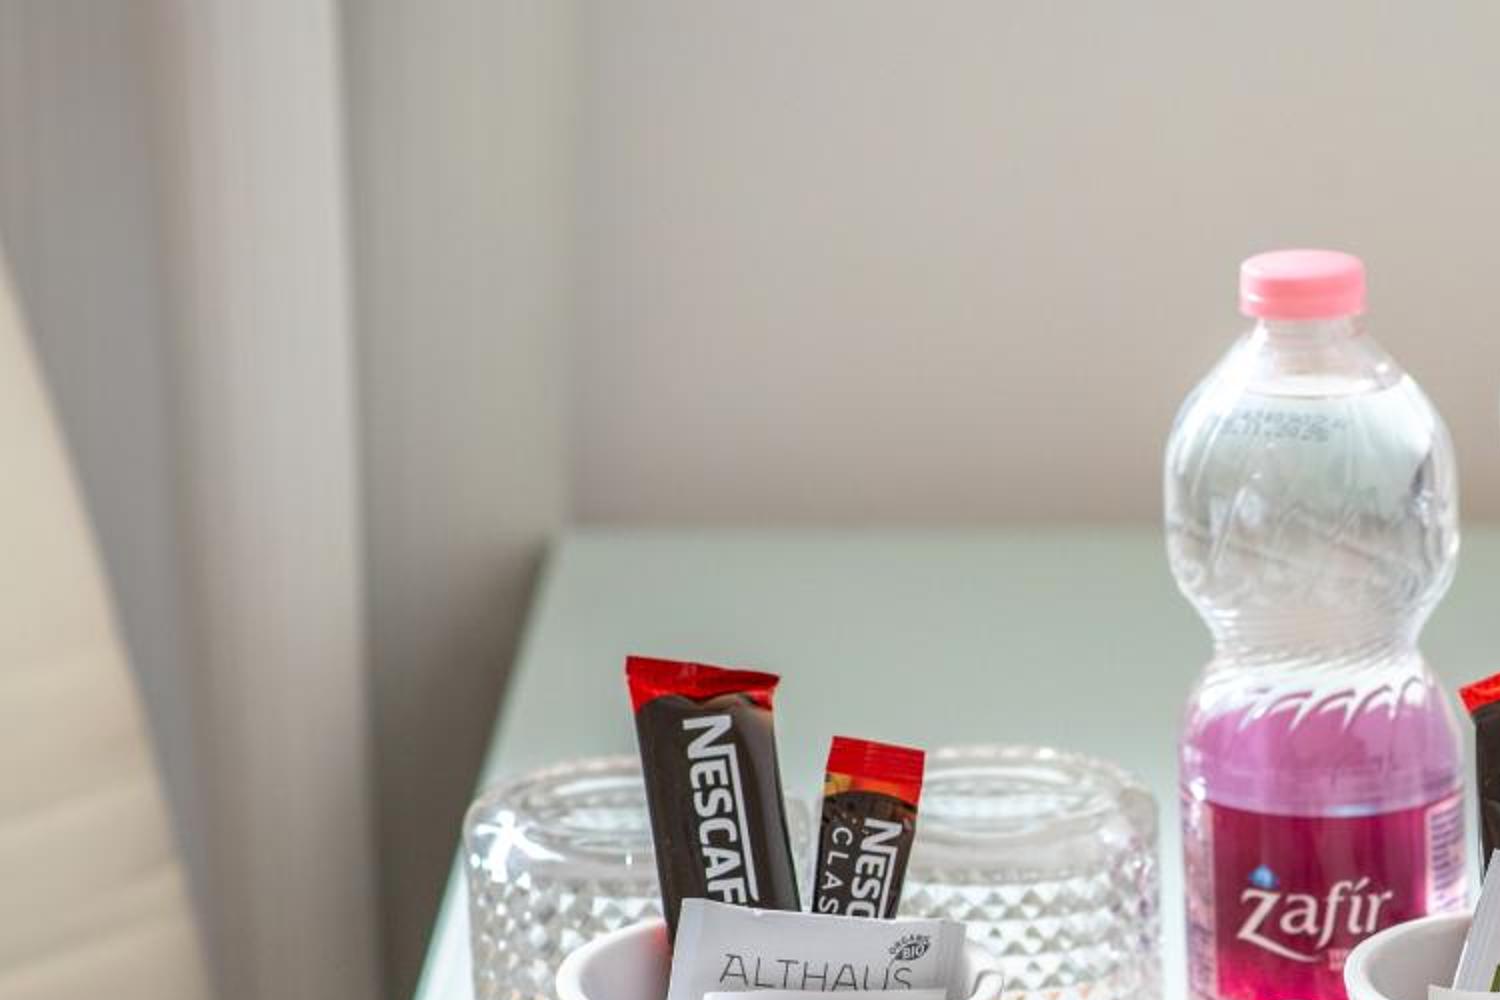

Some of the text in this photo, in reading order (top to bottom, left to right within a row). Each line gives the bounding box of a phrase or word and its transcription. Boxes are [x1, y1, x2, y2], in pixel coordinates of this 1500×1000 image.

[682, 715, 759, 903] NESCAF
[818, 827, 853, 913] CLAS
[846, 818, 902, 919] NESC
